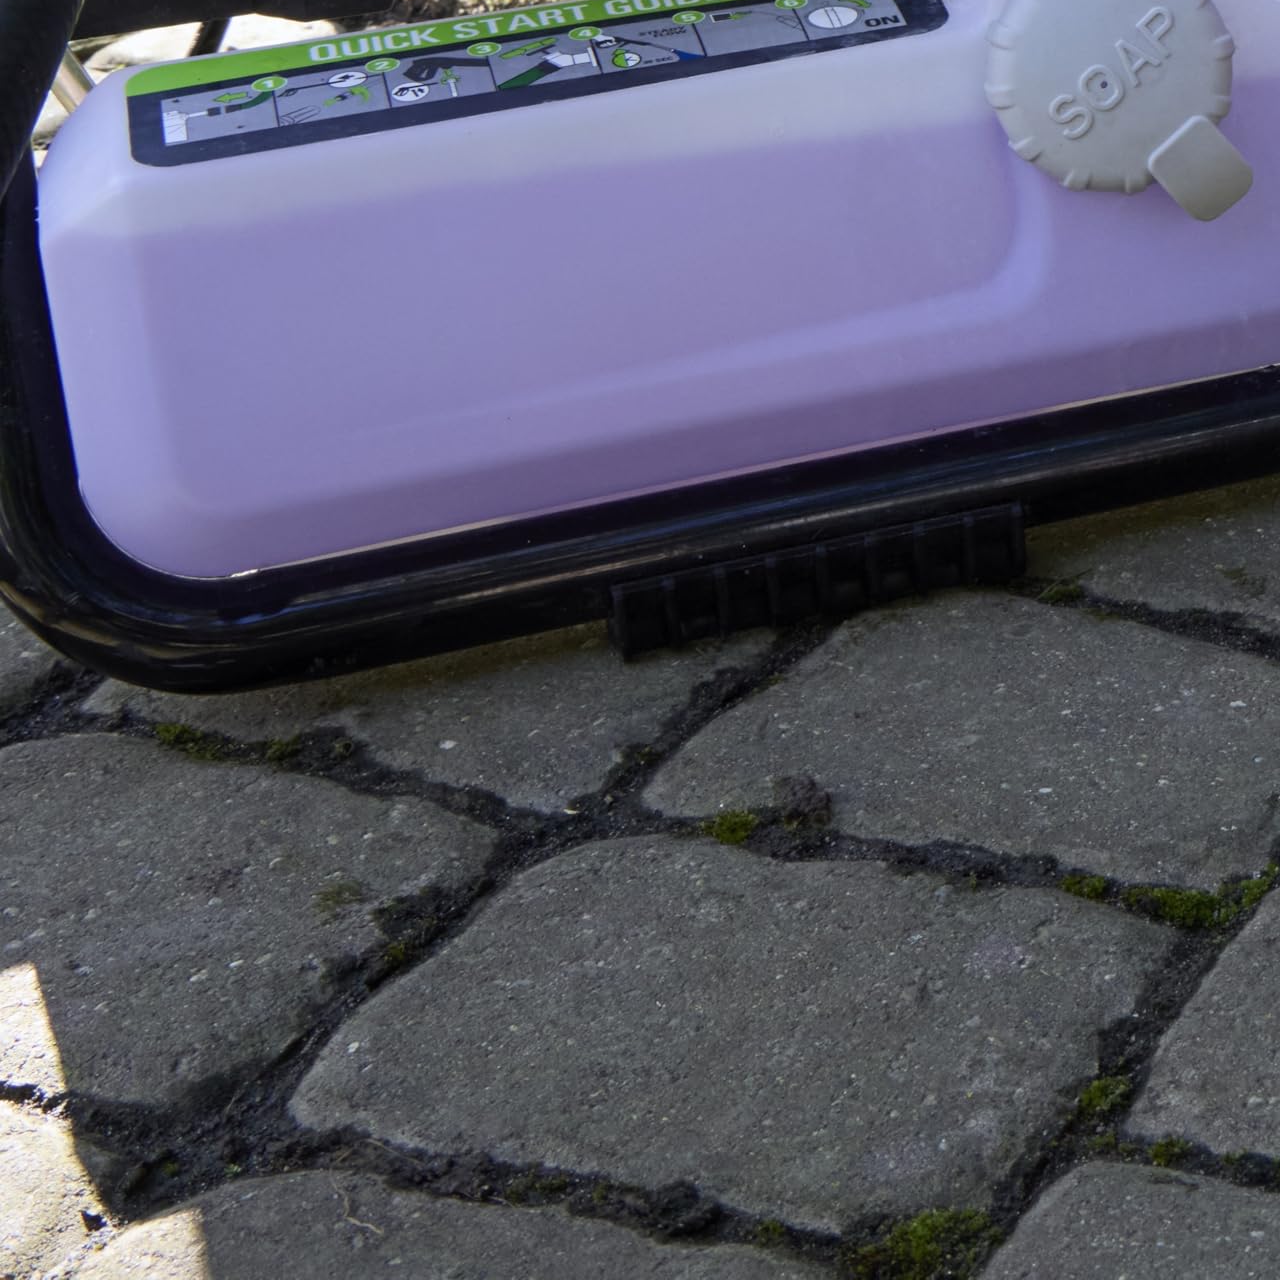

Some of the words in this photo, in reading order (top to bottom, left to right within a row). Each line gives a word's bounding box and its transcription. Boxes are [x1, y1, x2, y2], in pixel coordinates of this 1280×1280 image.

[681, 13, 697, 23] 5
[864, 14, 901, 29] ON
[308, 26, 441, 62] QUICK
[452, 2, 590, 41] START
[577, 28, 593, 39] 4
[477, 44, 492, 55] 3
[375, 60, 392, 71] 2
[1049, 6, 1174, 140] SOAP
